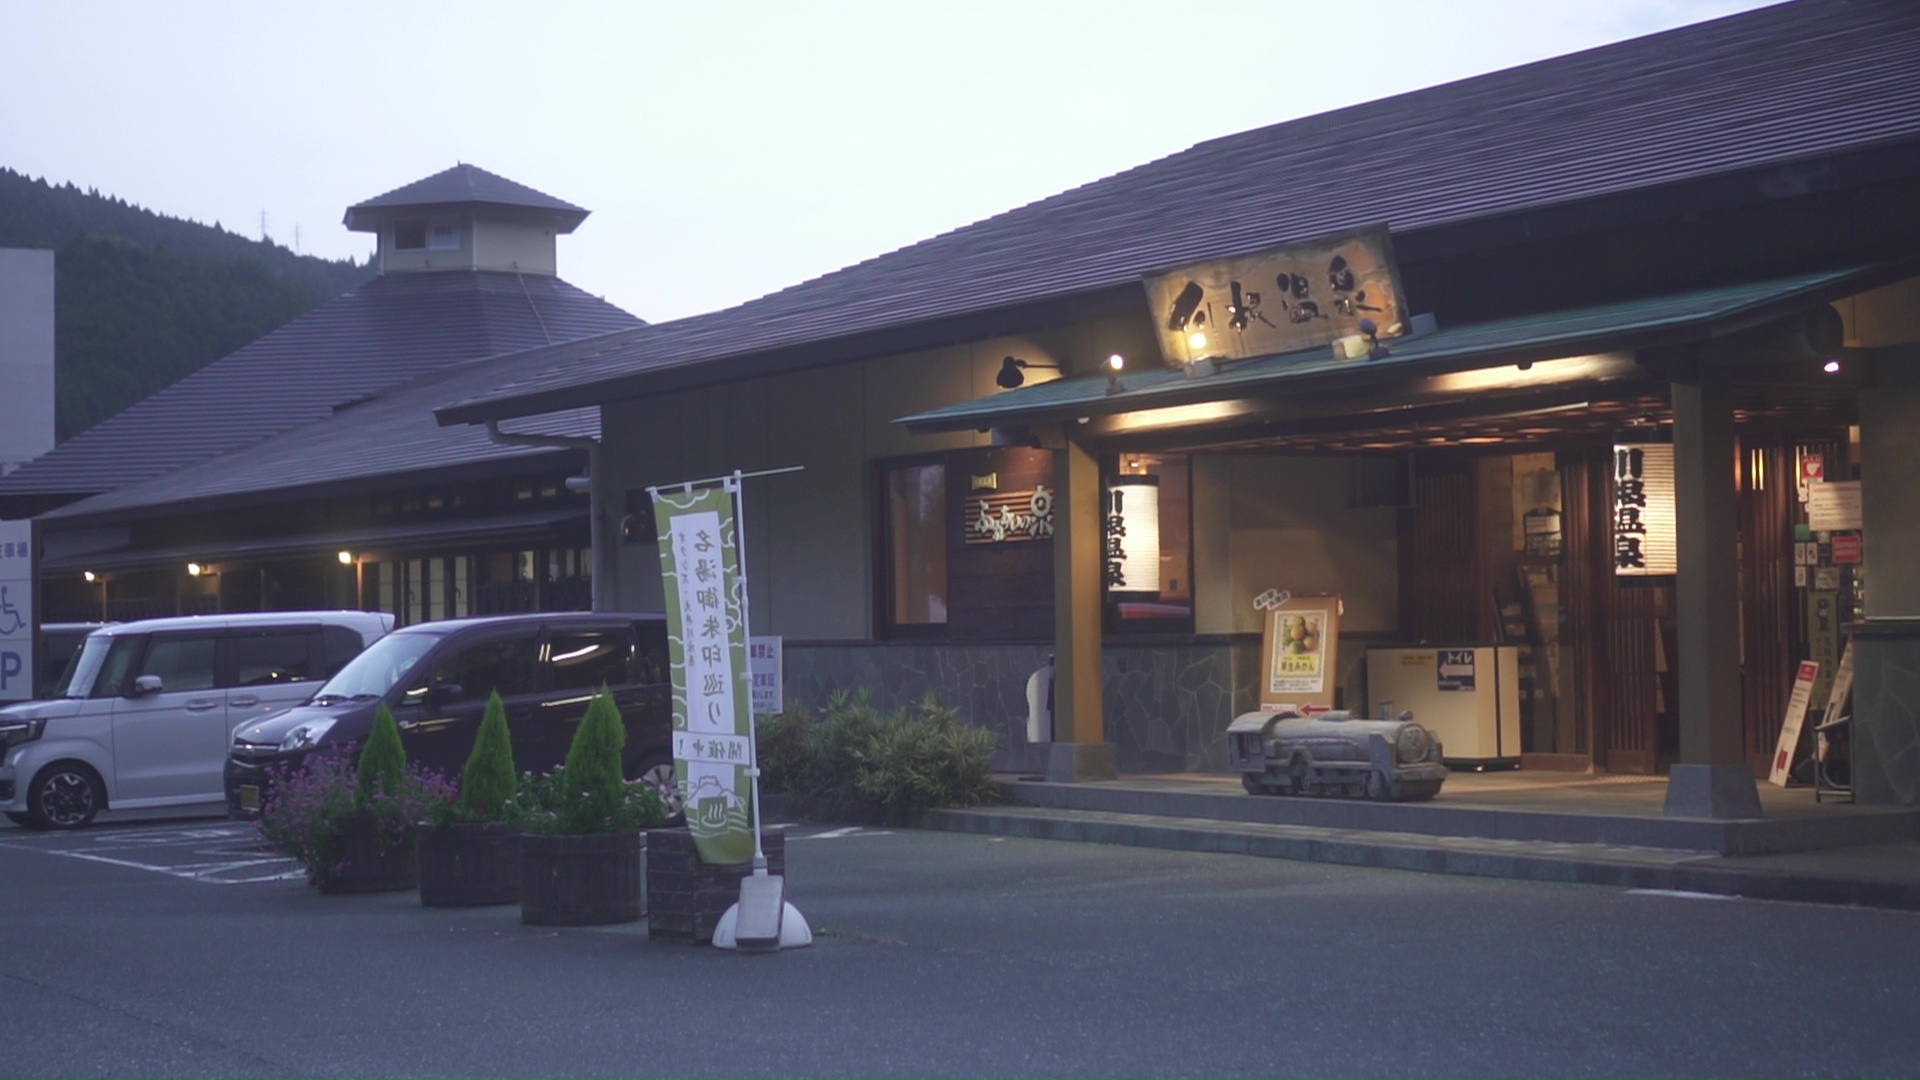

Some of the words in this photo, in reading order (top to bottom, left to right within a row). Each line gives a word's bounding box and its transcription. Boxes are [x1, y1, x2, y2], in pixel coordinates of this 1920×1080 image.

[1167, 254, 1383, 337] 川根温泉
[1, 651, 22, 690] P
[1448, 651, 1472, 663] トイレ
